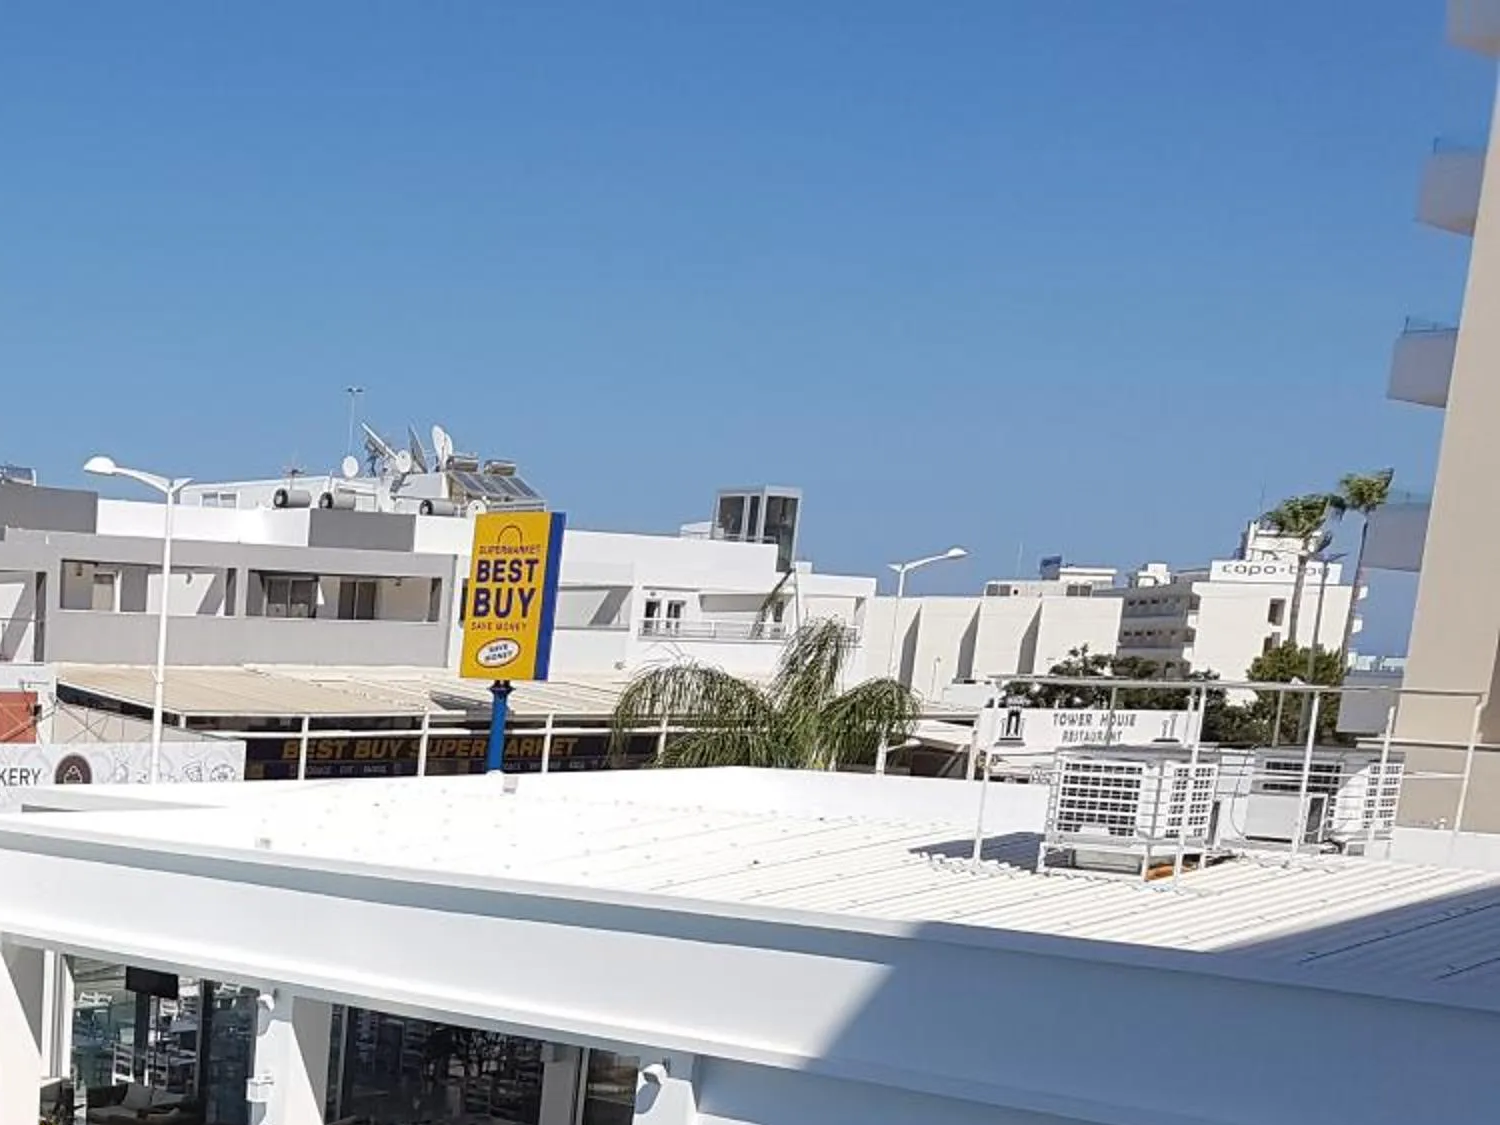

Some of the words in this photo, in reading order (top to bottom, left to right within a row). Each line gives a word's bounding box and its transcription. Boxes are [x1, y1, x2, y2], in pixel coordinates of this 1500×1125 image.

[476, 559, 540, 583] BEST
[1222, 563, 1277, 576] capo
[473, 587, 536, 618] BUY
[1053, 713, 1094, 727] TOWER
[1101, 713, 1137, 727] HOUSE
[1062, 730, 1123, 743] RESTAURANT
[281, 739, 348, 760] BEST
[353, 738, 403, 759] BUY
